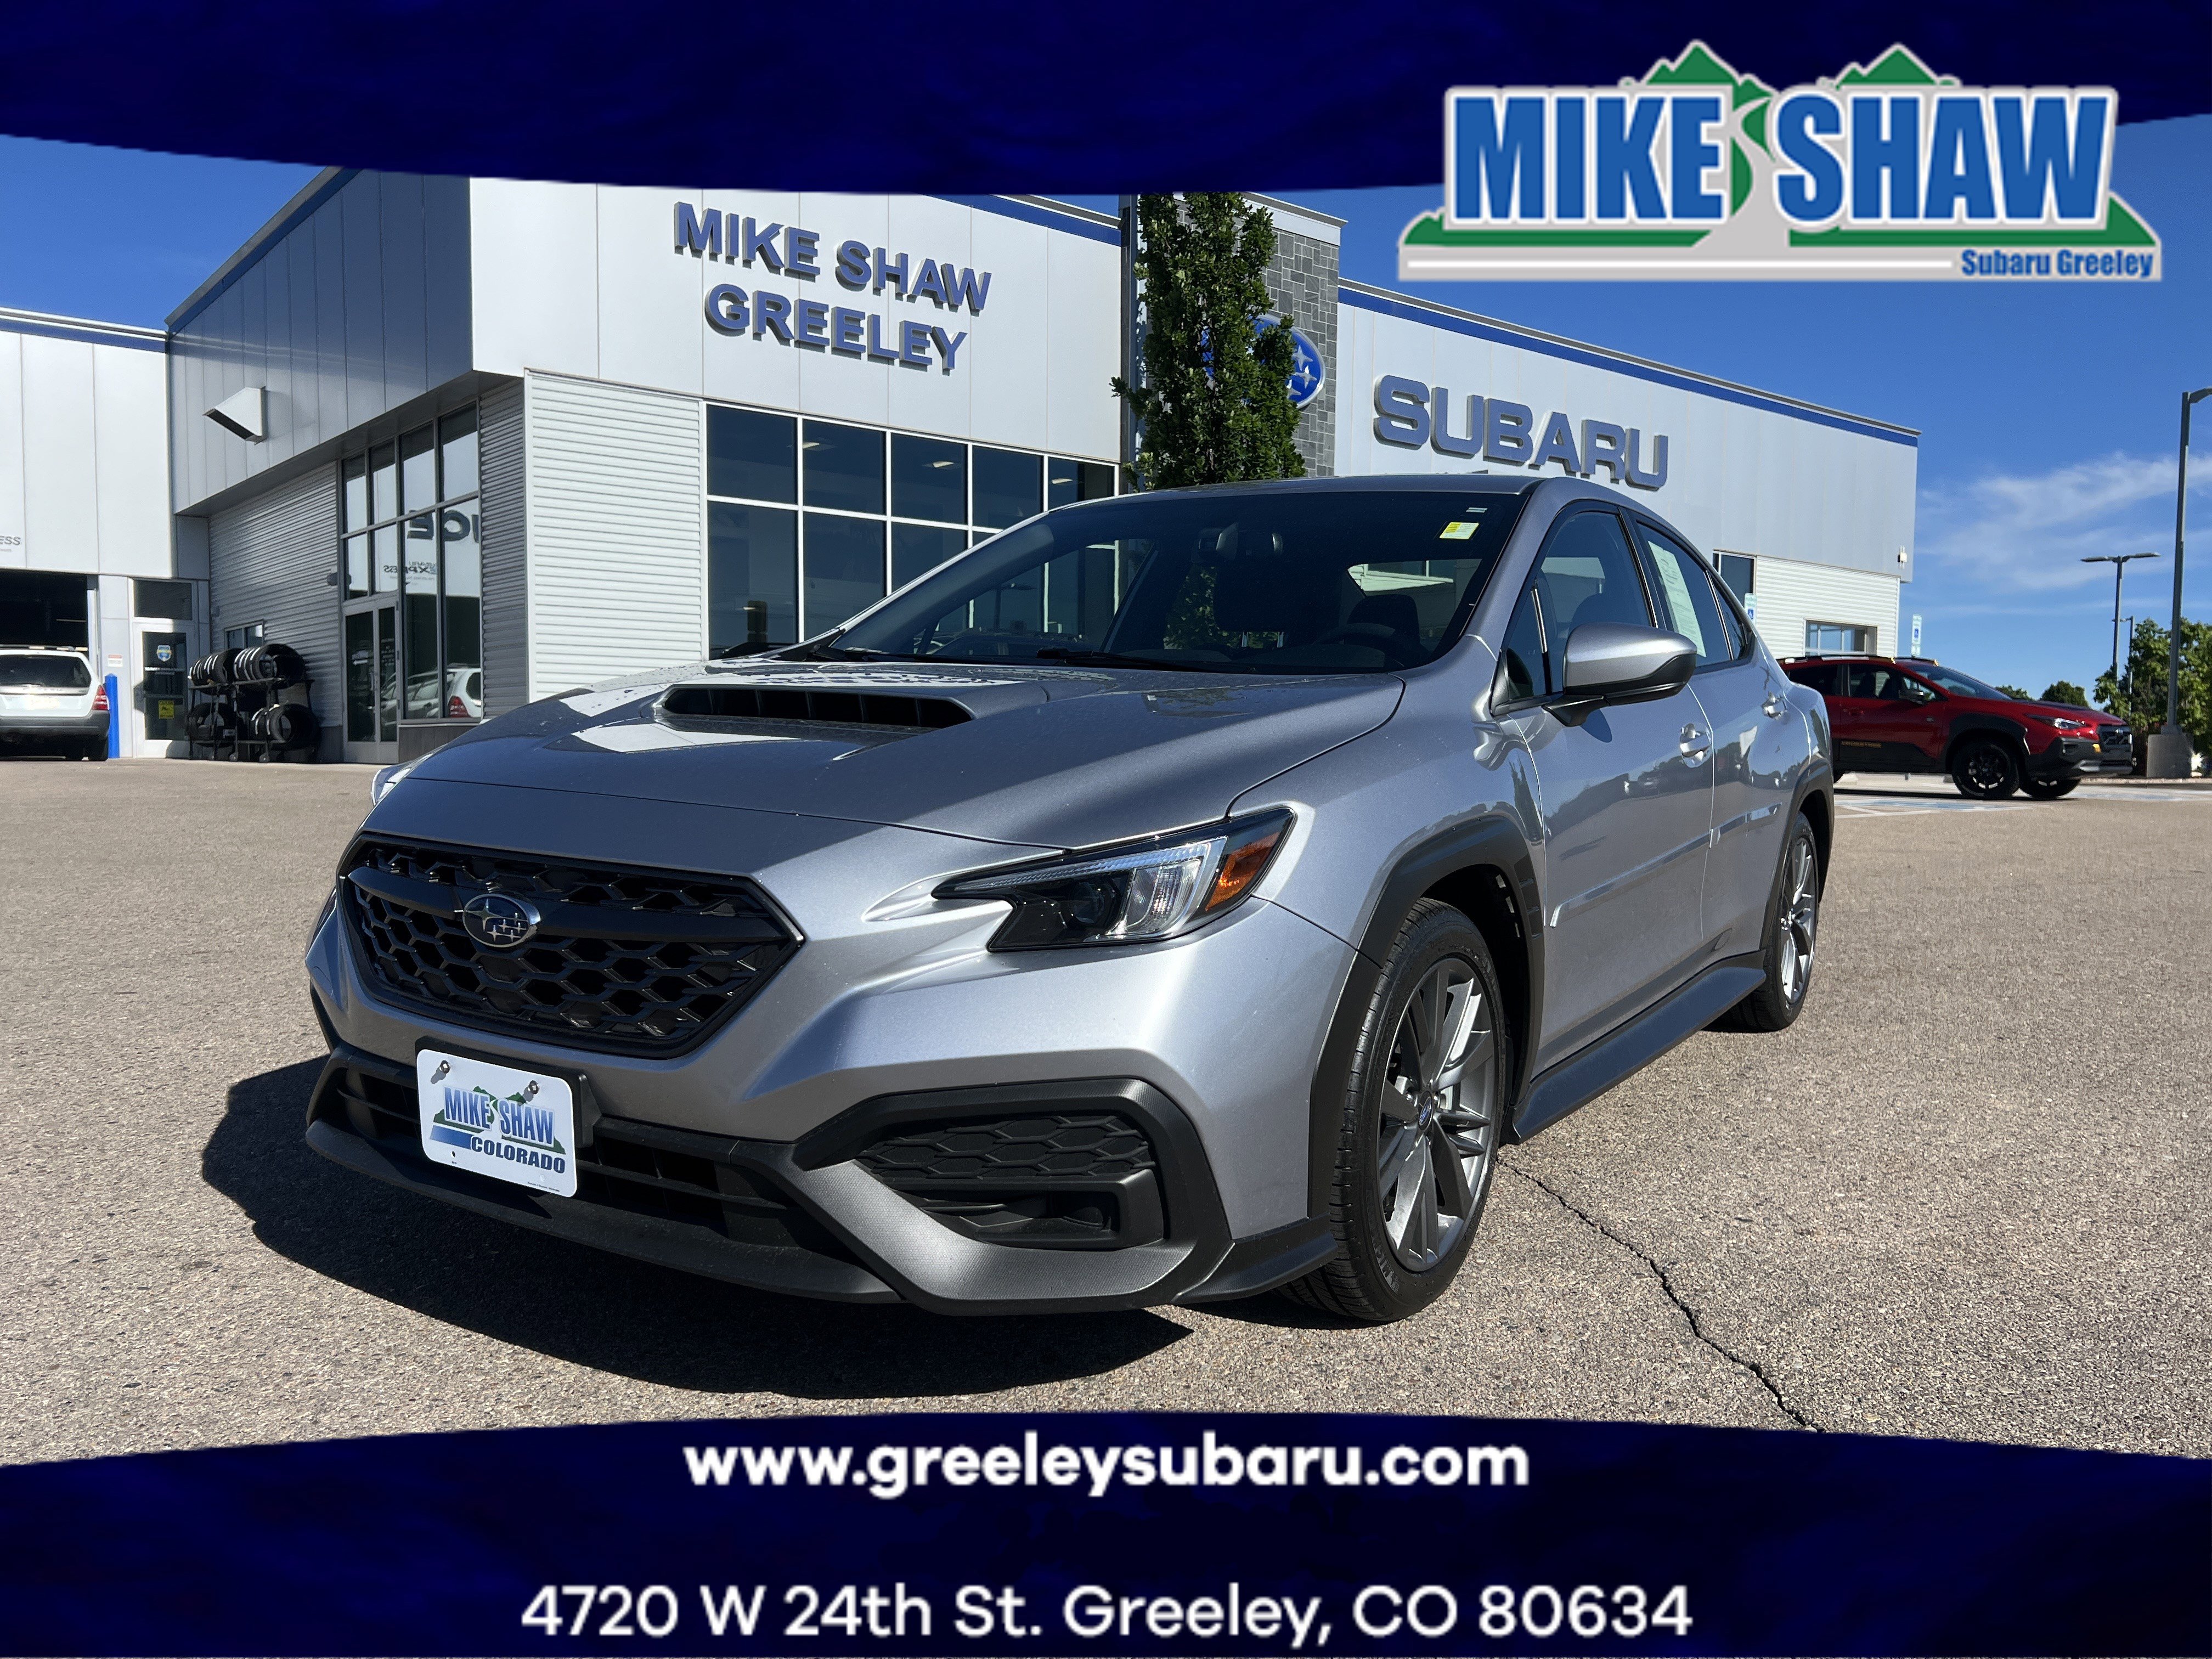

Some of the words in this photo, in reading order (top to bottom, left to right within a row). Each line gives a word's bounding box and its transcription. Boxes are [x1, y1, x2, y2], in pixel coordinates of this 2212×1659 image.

[674, 201, 821, 283] MIKE
[835, 240, 992, 317] SHAW
[704, 284, 968, 376] GREELEY
[1374, 375, 1669, 490] SUBARU
[444, 1086, 491, 1130] MIKE
[498, 1102, 554, 1146] SHAW
[471, 1137, 566, 1174] COLORADO
